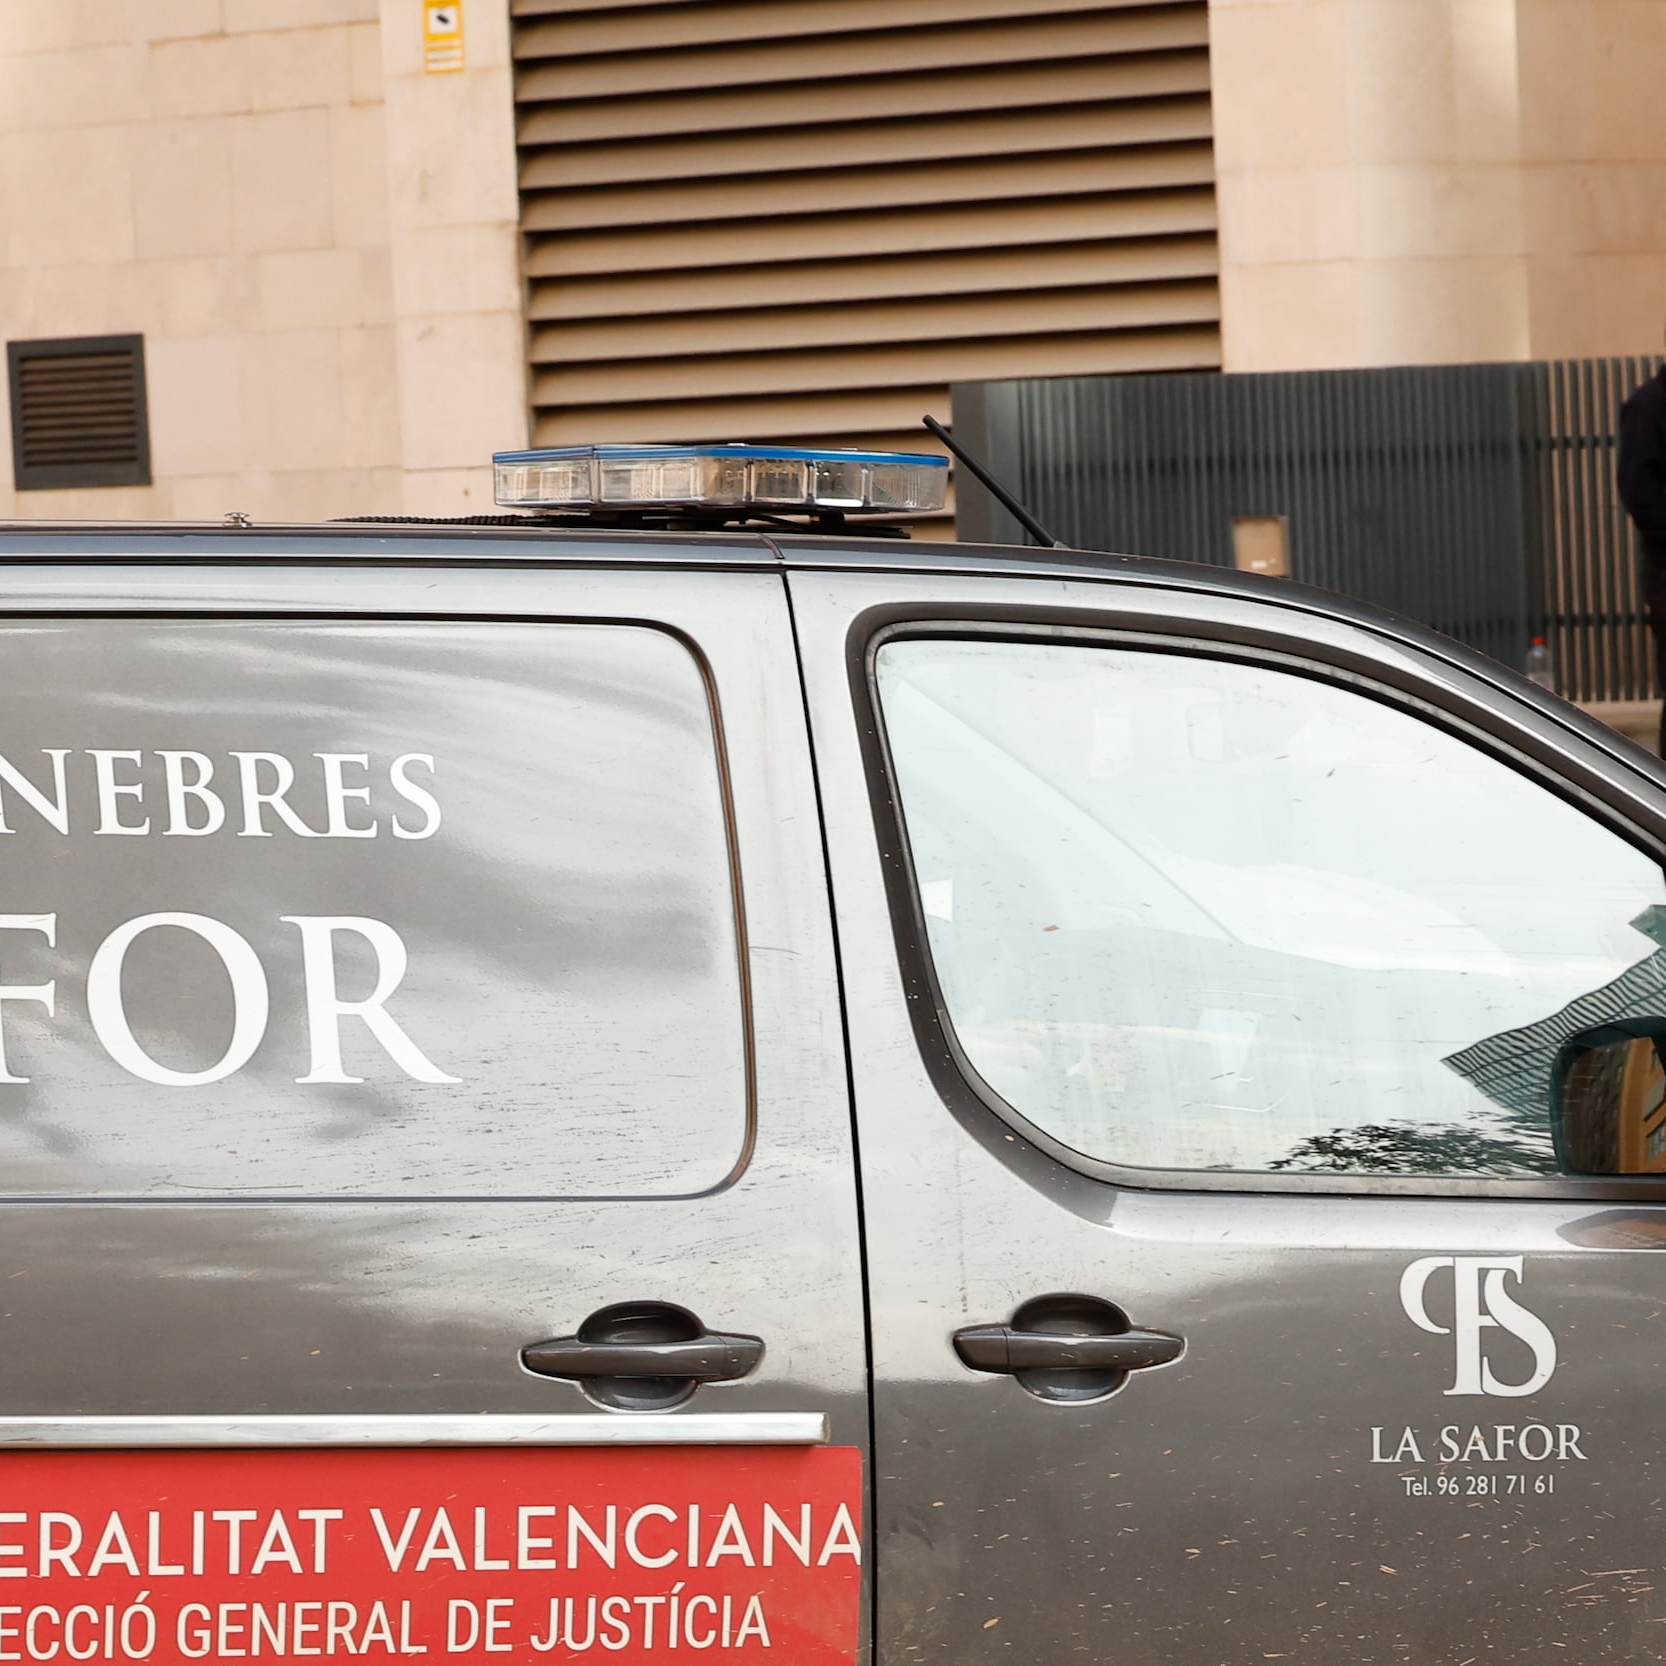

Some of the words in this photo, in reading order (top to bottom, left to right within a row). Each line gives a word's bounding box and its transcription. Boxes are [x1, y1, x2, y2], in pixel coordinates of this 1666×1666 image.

[1369, 1426, 1426, 1463] LA
[1439, 1424, 1589, 1462] SAFOR
[1401, 1476, 1433, 1496] Tel.
[1437, 1476, 1460, 1496] 96
[1465, 1475, 1497, 1495] 281
[1505, 1474, 1525, 1494] 71
[1534, 1474, 1555, 1494] 61
[369, 1502, 862, 1574] VALENCIANA
[175, 1599, 428, 1659] GENERAL
[446, 1598, 515, 1653] DE
[530, 1581, 771, 1652] JUSTÍCIA
